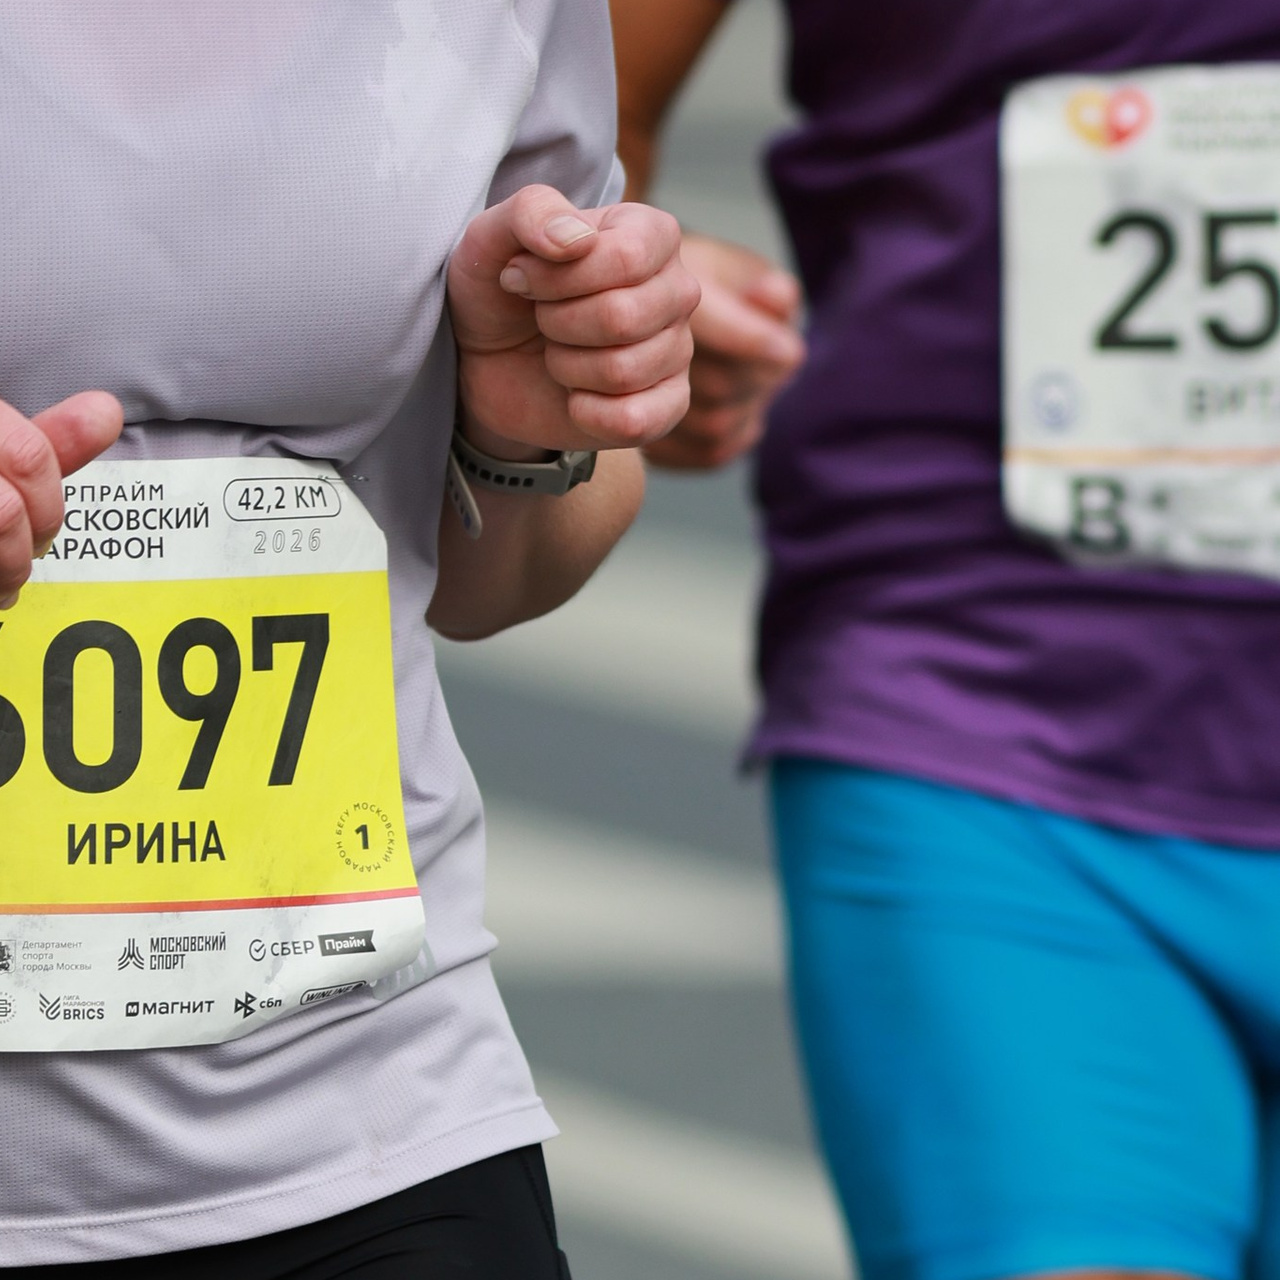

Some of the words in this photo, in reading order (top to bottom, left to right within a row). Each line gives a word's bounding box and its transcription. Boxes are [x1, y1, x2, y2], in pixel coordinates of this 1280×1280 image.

[1093, 208, 1280, 354] 25
[64, 480, 165, 502] РПРАЙМ
[237, 485, 286, 514] 42,2
[294, 485, 328, 508] КМ
[64, 501, 210, 532] СКОВСКИЙ
[40, 536, 165, 560] АРАФОН
[253, 527, 321, 554] 2026
[335, 809, 350, 836] БЕГУ
[353, 802, 395, 863] МОСКОВСКИЙ
[67, 819, 226, 865] ИРИНА
[354, 824, 370, 850] 1
[335, 841, 381, 872] МАРАФОН
[21, 940, 82, 950] Департамент
[150, 931, 226, 953] МОСКОВСКИЙ
[270, 940, 315, 956] СБЕР
[324, 936, 367, 952] Прайм
[21, 951, 54, 962] спорта
[21, 963, 54, 972] города
[56, 962, 92, 971] Москвы
[150, 954, 186, 970] СПОРТ
[63, 1008, 105, 1020] BRICS
